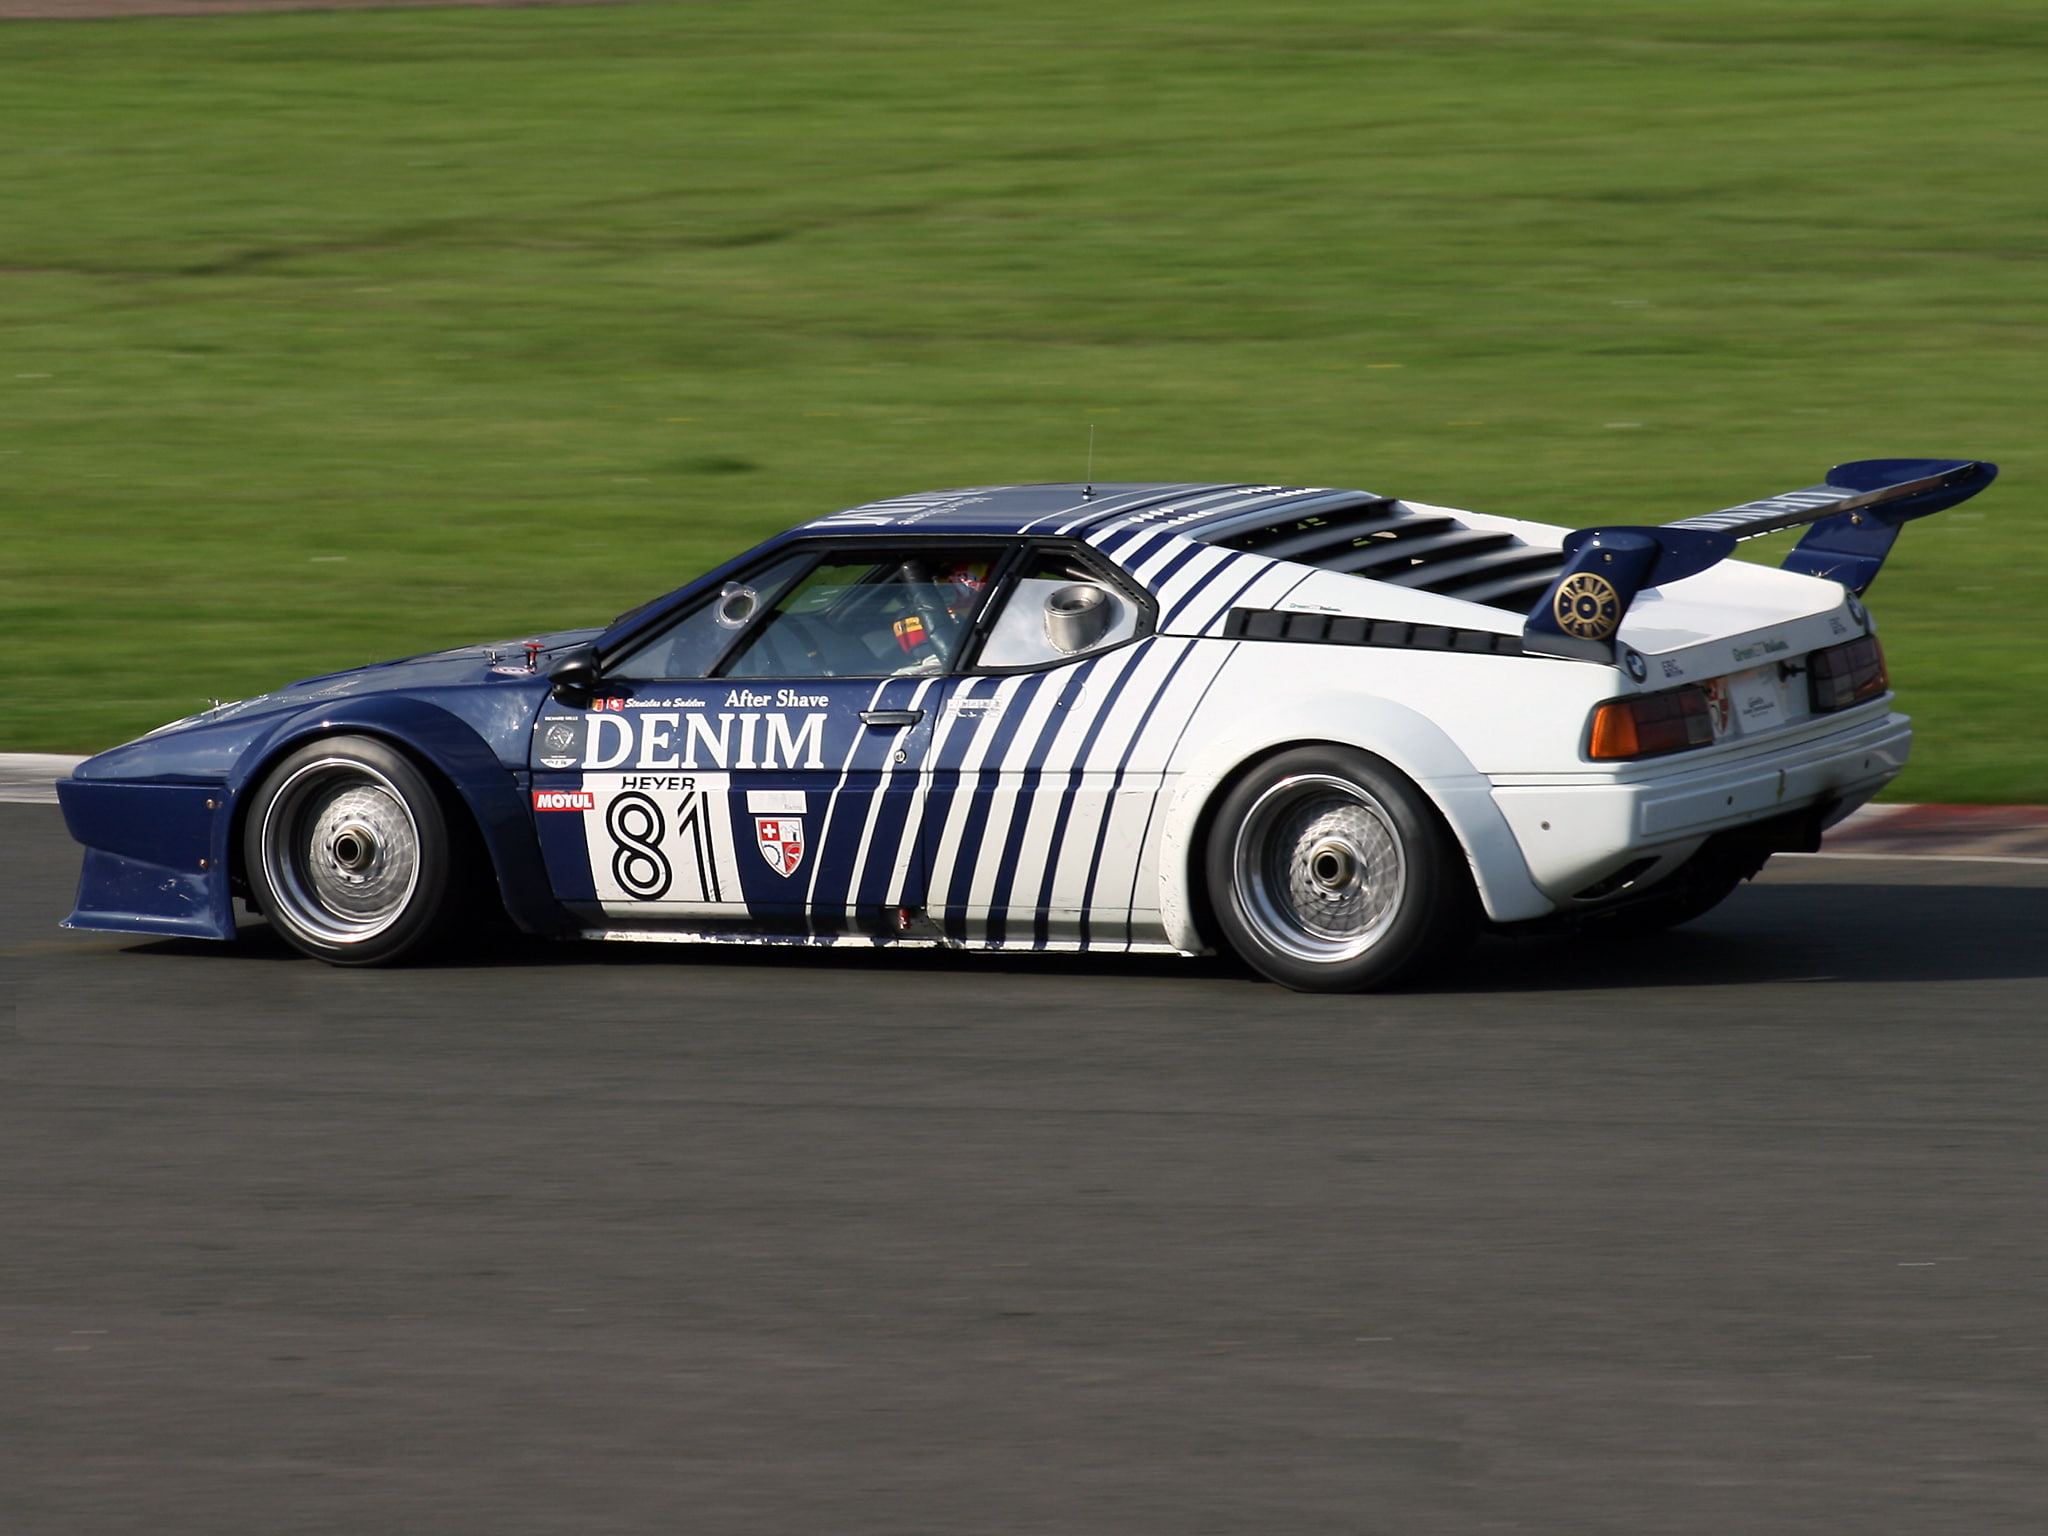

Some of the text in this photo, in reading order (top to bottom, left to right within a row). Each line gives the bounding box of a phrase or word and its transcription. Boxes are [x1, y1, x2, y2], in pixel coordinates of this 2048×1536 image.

[725, 689, 829, 708] After Shave
[581, 712, 828, 770] DENIM
[621, 776, 696, 790] HEYER
[536, 793, 594, 809] MOTUL
[605, 791, 723, 902] 81
